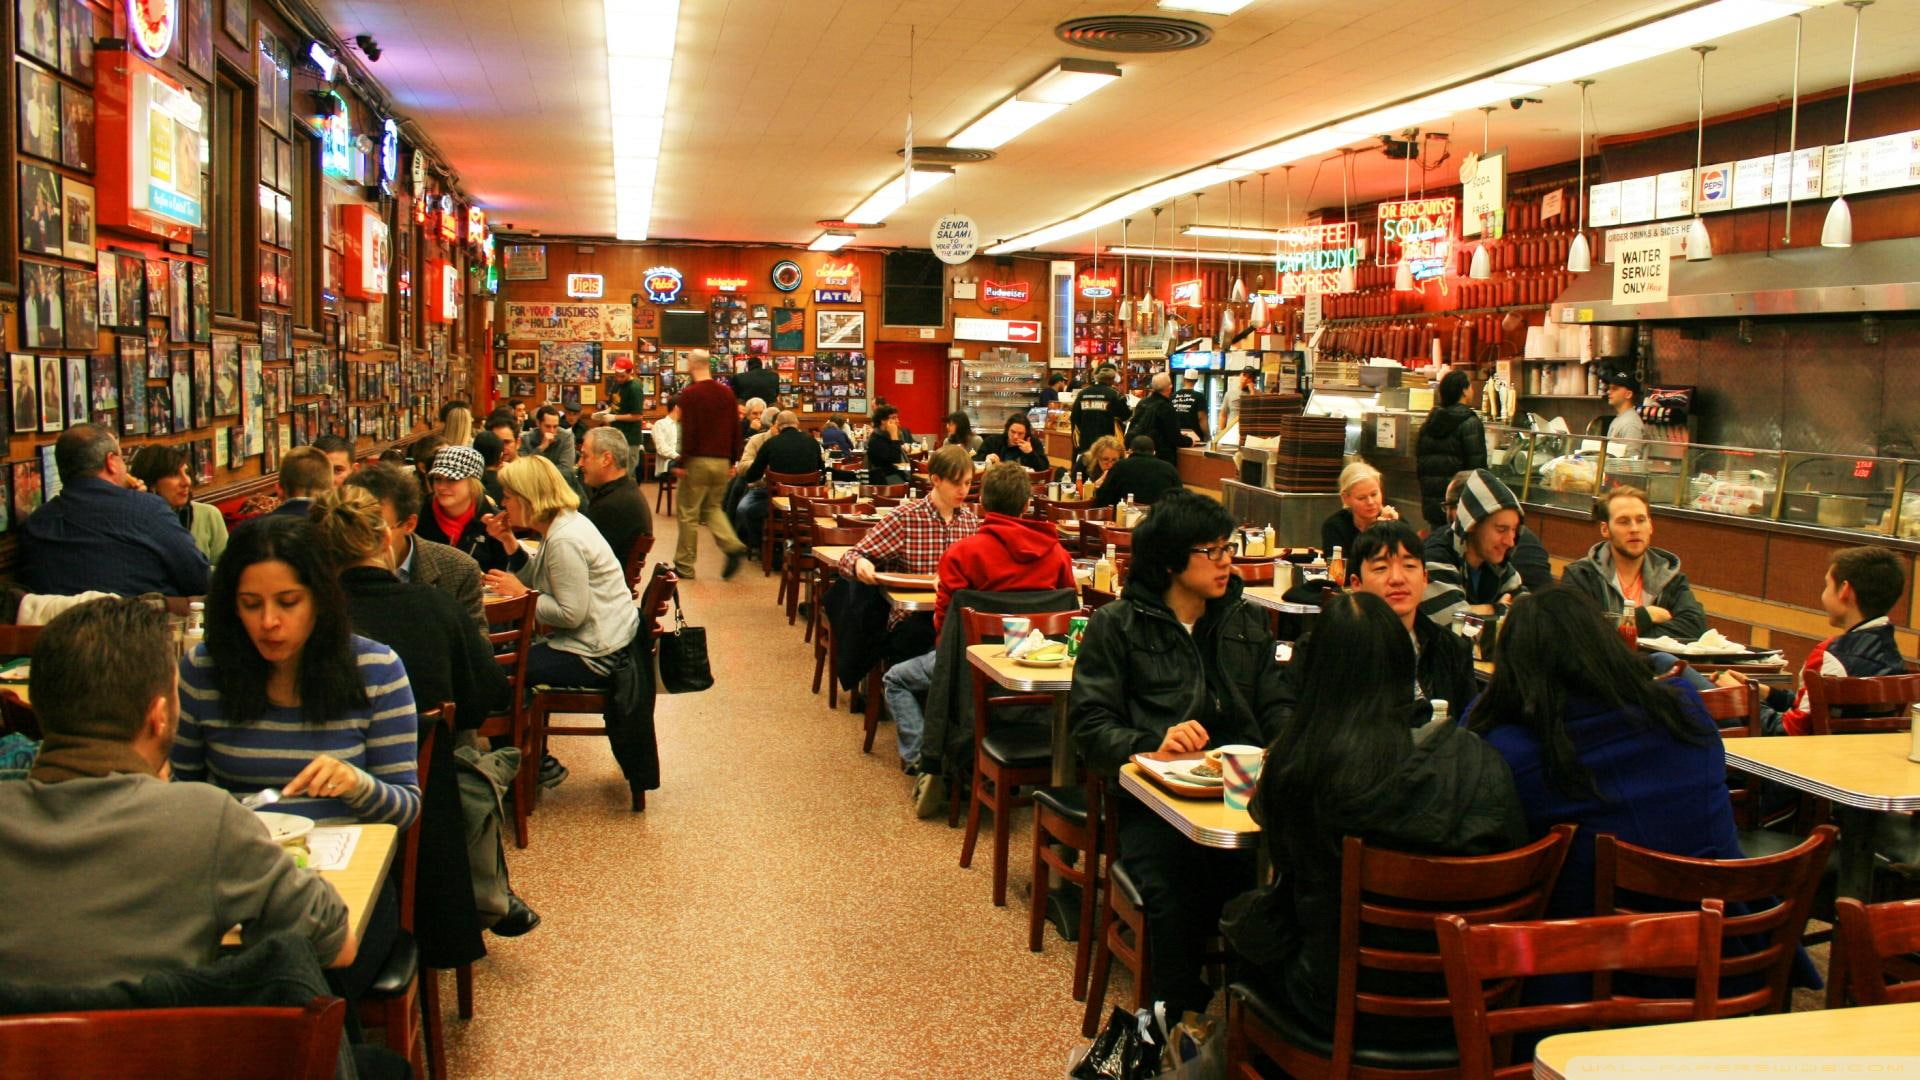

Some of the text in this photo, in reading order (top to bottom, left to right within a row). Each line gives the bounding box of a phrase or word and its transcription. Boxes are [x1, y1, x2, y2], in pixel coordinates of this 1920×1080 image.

[1703, 180, 1724, 191] PEPSI
[936, 230, 972, 239] SALAMI
[1289, 223, 1347, 248] COFFEE
[1608, 231, 1629, 242] ORDER
[1629, 229, 1652, 241] DRINKS
[1653, 228, 1659, 237] &
[1660, 224, 1680, 237] SIDES
[1622, 249, 1661, 264] WAITER
[1621, 265, 1661, 280] SERVICE
[986, 287, 1027, 298] Budweiser
[1622, 283, 1646, 294] ONLY
[821, 291, 854, 302] ATM
[510, 306, 600, 319] FOR YOUR BUSINESS
[530, 319, 569, 329] HOLIDAY
